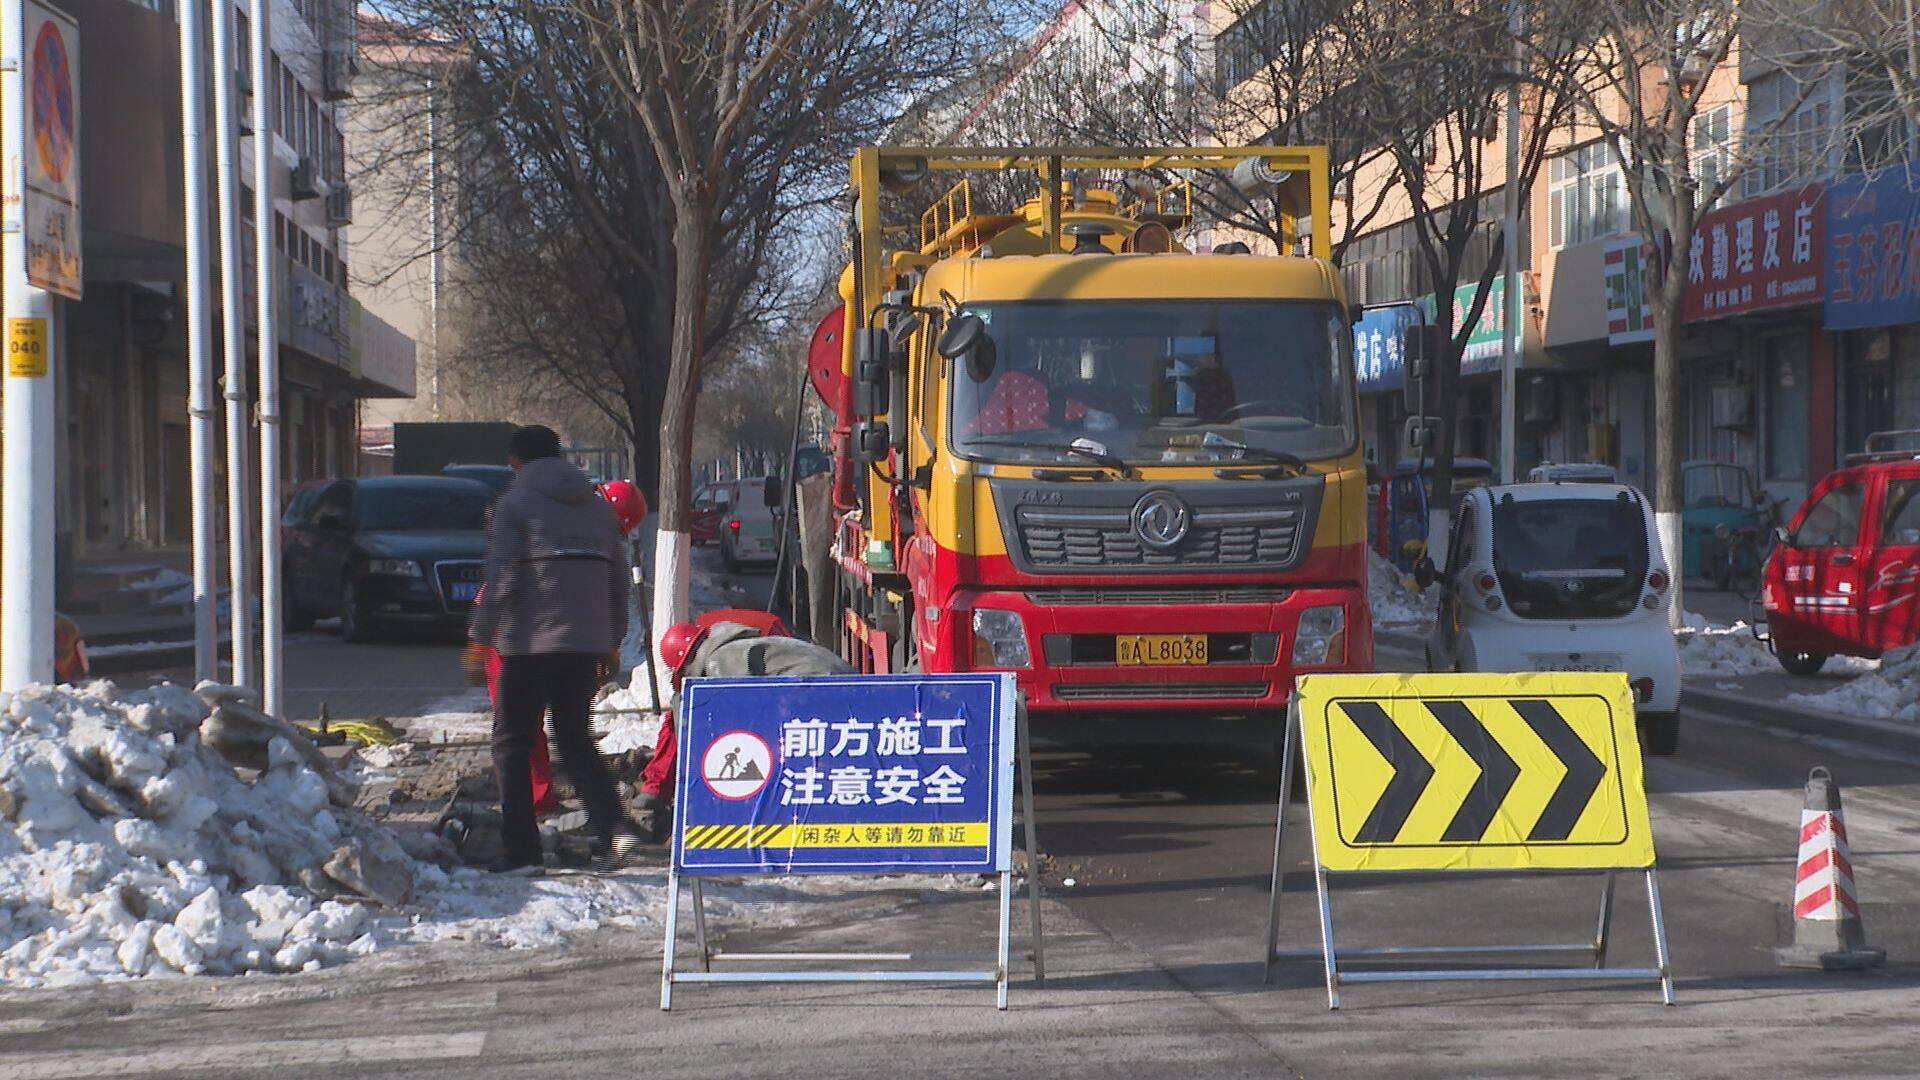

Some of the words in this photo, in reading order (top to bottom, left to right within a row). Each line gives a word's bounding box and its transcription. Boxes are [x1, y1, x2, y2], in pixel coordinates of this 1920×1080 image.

[783, 718, 967, 756] 前方施工
[781, 764, 966, 806] 注意安全
[801, 826, 966, 843] 闲杂人等请勿靠近
